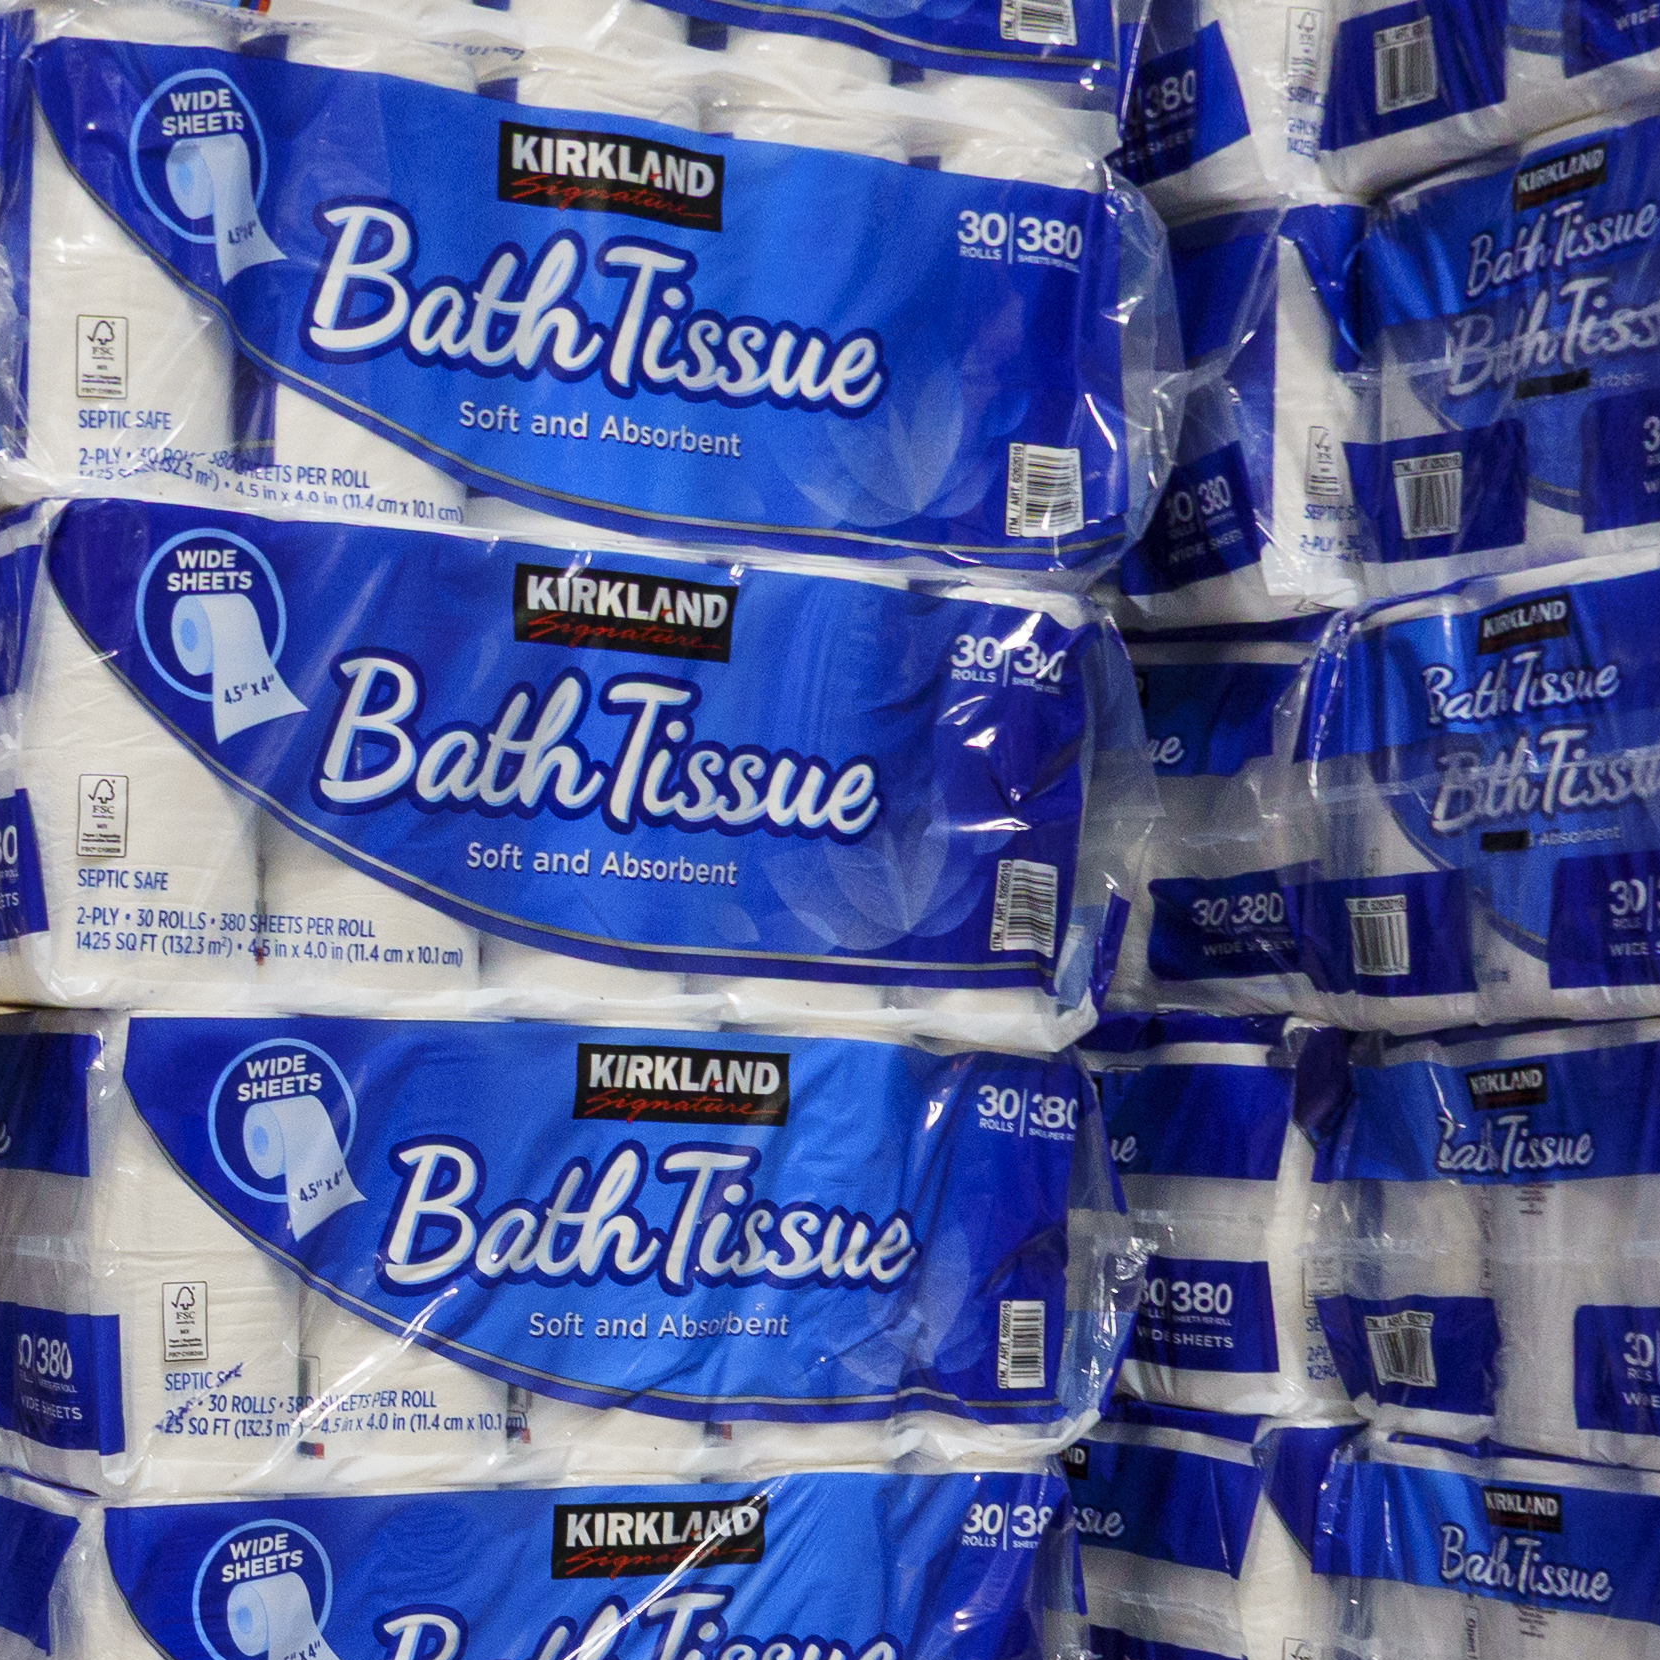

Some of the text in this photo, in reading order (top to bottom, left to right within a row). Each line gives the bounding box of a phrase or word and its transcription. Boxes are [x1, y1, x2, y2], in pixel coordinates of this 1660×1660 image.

[170, 89, 231, 111] WIDE
[162, 111, 244, 136] SHEETS
[511, 133, 716, 198] KIRKLAND
[1517, 149, 1604, 192] KIRKLAND
[1467, 200, 1660, 297] Bath Tissue
[309, 206, 882, 408] Bath Tissue
[176, 550, 237, 569] WIDE
[167, 571, 252, 591] SHEETS
[526, 575, 728, 628] KIRKLAND
[950, 634, 998, 670] 30
[951, 669, 997, 684] ROLLS
[320, 657, 880, 832] Bath Tissue
[92, 804, 114, 815] FSC
[467, 842, 738, 886] Soft and Absorbent
[78, 869, 168, 891] SEPTIC SAFE
[77, 907, 375, 938] 2-PLY 30 ROLLS 380 SHEETS PER ROLL
[76, 933, 110, 950] 1425
[116, 934, 137, 952] SQ
[140, 935, 157, 952] FT
[162, 936, 204, 956] (132.3
[275, 941, 286, 958] in
[291, 946, 299, 958] x
[305, 940, 327, 959] 4.0
[332, 942, 343, 960] in
[348, 942, 379, 962] (11.4
[245, 1056, 308, 1077] WIDE
[589, 1053, 780, 1096] KIRKLAND
[238, 1070, 323, 1101] SHEETS
[384, 1142, 917, 1286] Bath Tissue
[1172, 1283, 1232, 1315] 380
